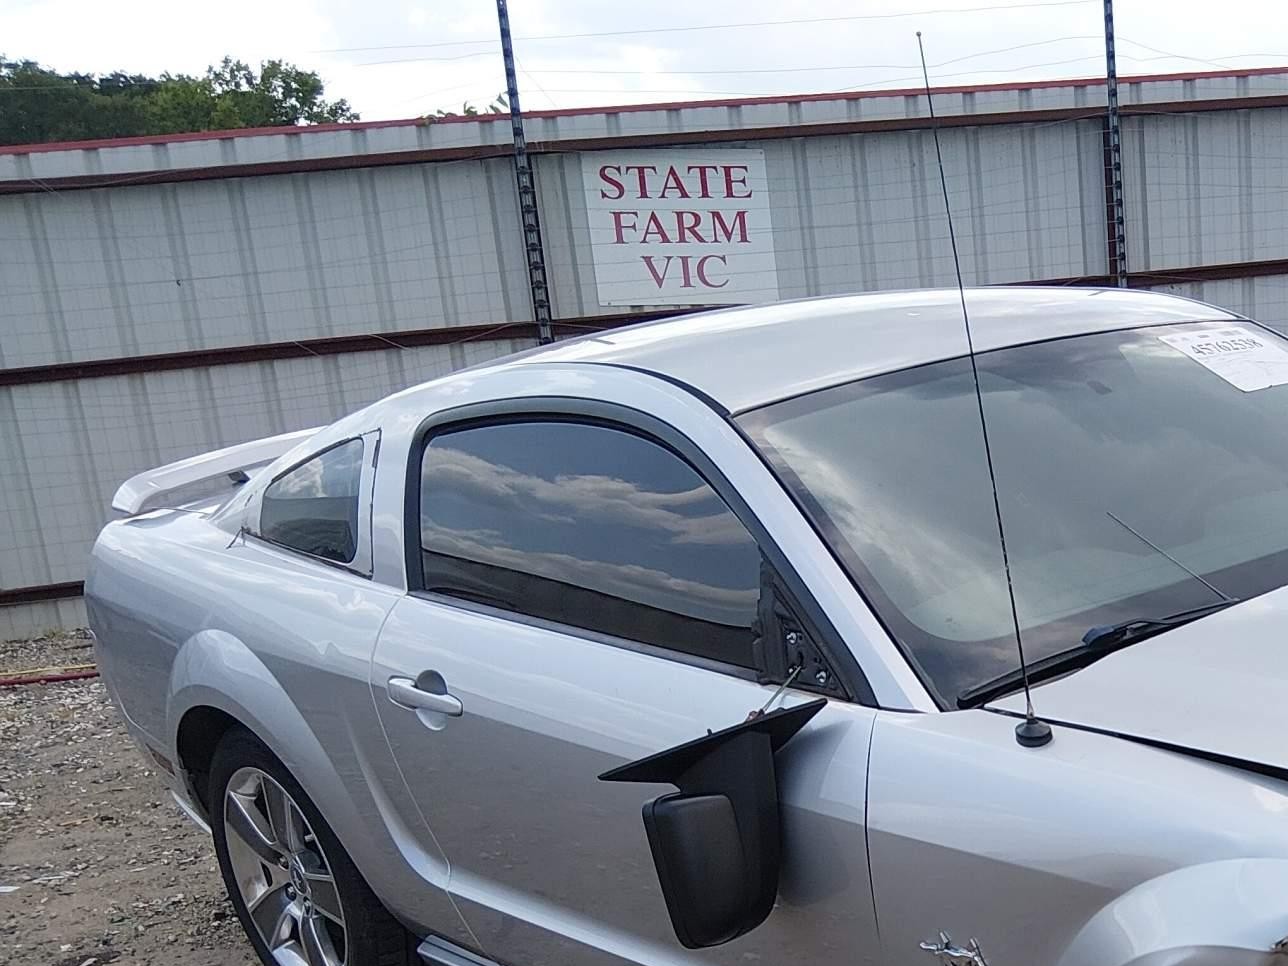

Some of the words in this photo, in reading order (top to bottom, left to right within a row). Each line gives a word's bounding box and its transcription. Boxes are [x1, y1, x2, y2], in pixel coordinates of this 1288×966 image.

[599, 165, 753, 200] STATE
[609, 210, 751, 244] FARM
[640, 254, 730, 289] VIC
[1190, 338, 1264, 356] 45762538
